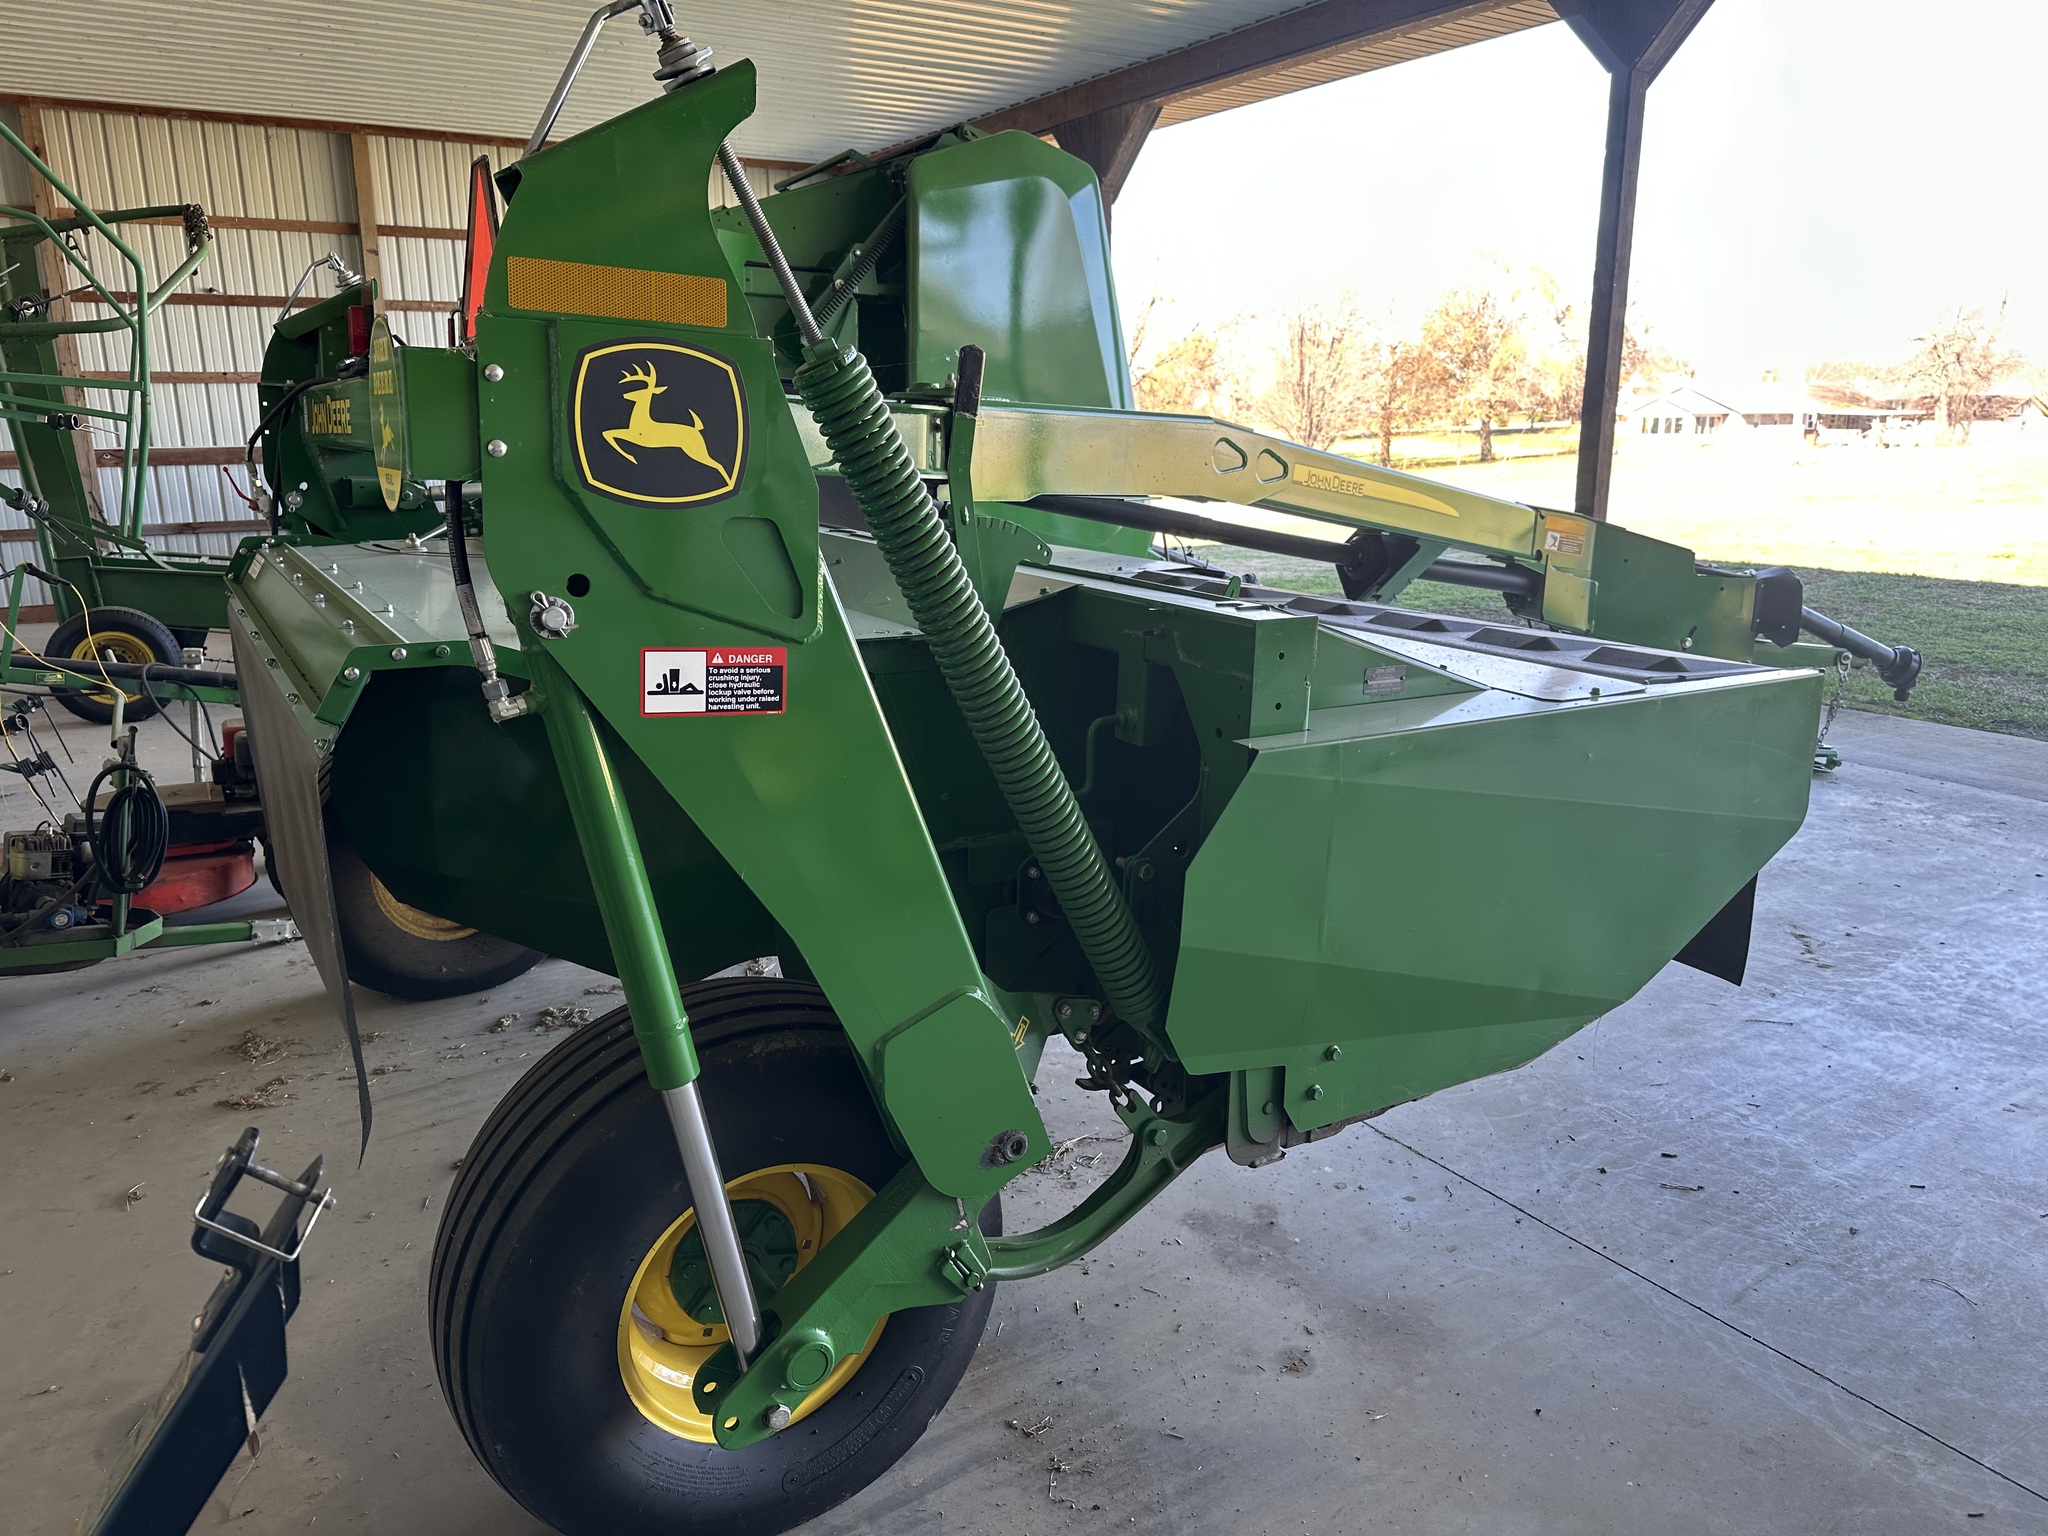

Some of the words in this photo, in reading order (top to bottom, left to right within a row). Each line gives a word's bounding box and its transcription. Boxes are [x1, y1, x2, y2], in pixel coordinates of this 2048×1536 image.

[373, 370, 393, 395] DEERE
[312, 400, 327, 434] JOHN
[326, 395, 352, 434] DEERE
[1303, 470, 1332, 489] JOHN
[1332, 475, 1365, 495] DEERE
[728, 654, 773, 664] DANGER
[708, 674, 739, 682] crushing
[740, 674, 762, 682] injury,
[728, 681, 761, 689] hydraulic
[708, 689, 732, 697] lockup
[708, 696, 736, 704] working
[737, 695, 758, 703] under
[758, 694, 780, 702] raised
[708, 703, 745, 711] harvesting
[745, 702, 761, 710] unit.
